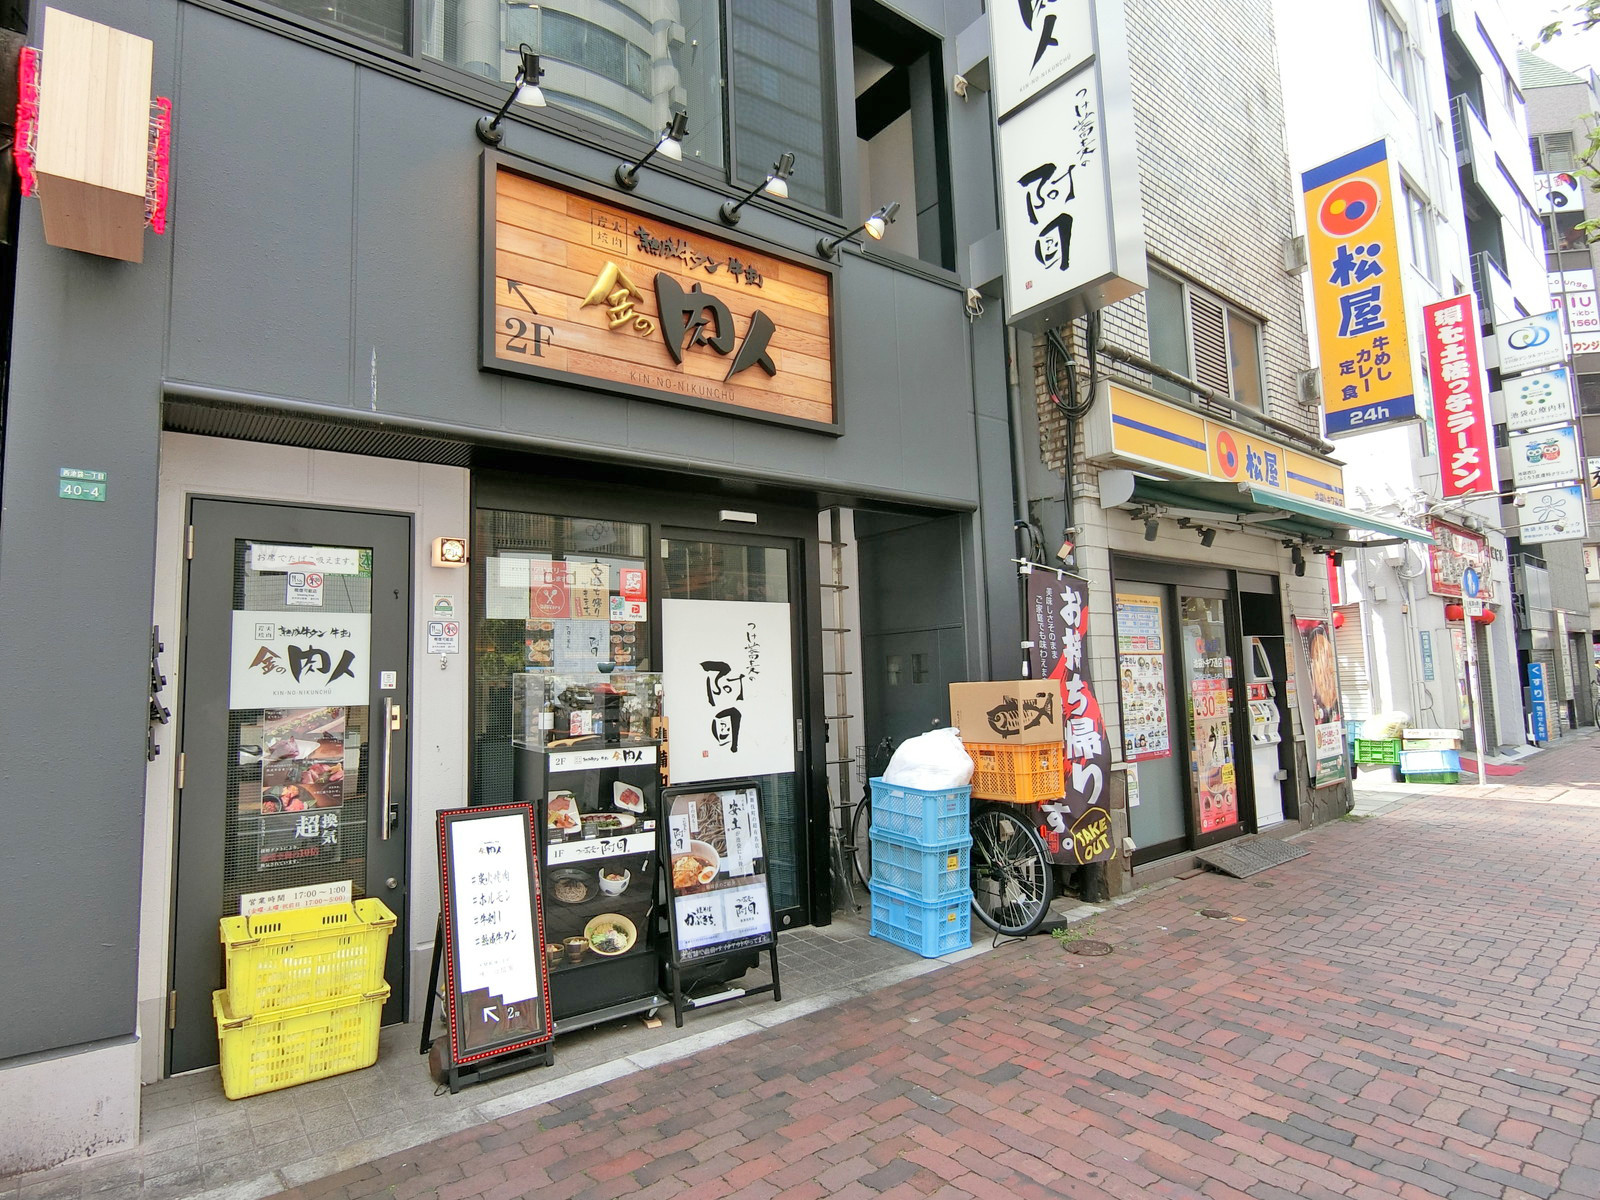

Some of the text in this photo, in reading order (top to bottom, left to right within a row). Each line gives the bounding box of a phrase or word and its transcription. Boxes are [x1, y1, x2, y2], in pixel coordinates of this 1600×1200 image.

[1017, 0, 1060, 76] 人
[1329, 243, 1386, 339] 松屋
[504, 317, 556, 359] 2F
[1571, 318, 1598, 328] 1560
[1372, 336, 1392, 382] 牛めし
[1565, 339, 1600, 351] ウンジ
[1339, 360, 1359, 401] 定食
[1356, 349, 1373, 393] カレー
[1349, 405, 1390, 425] 24h
[1433, 304, 1482, 489] 環七土佐っ子ラーメン
[1246, 444, 1280, 488] 松屋
[63, 484, 100, 497] 40-4
[1059, 585, 1104, 805] お持ち帰り
[1531, 665, 1543, 698] くすり
[555, 757, 566, 766] 2F
[1075, 817, 1108, 847] TAKE
[1084, 833, 1110, 860] OUT
[248, 894, 286, 906] 営業時間
